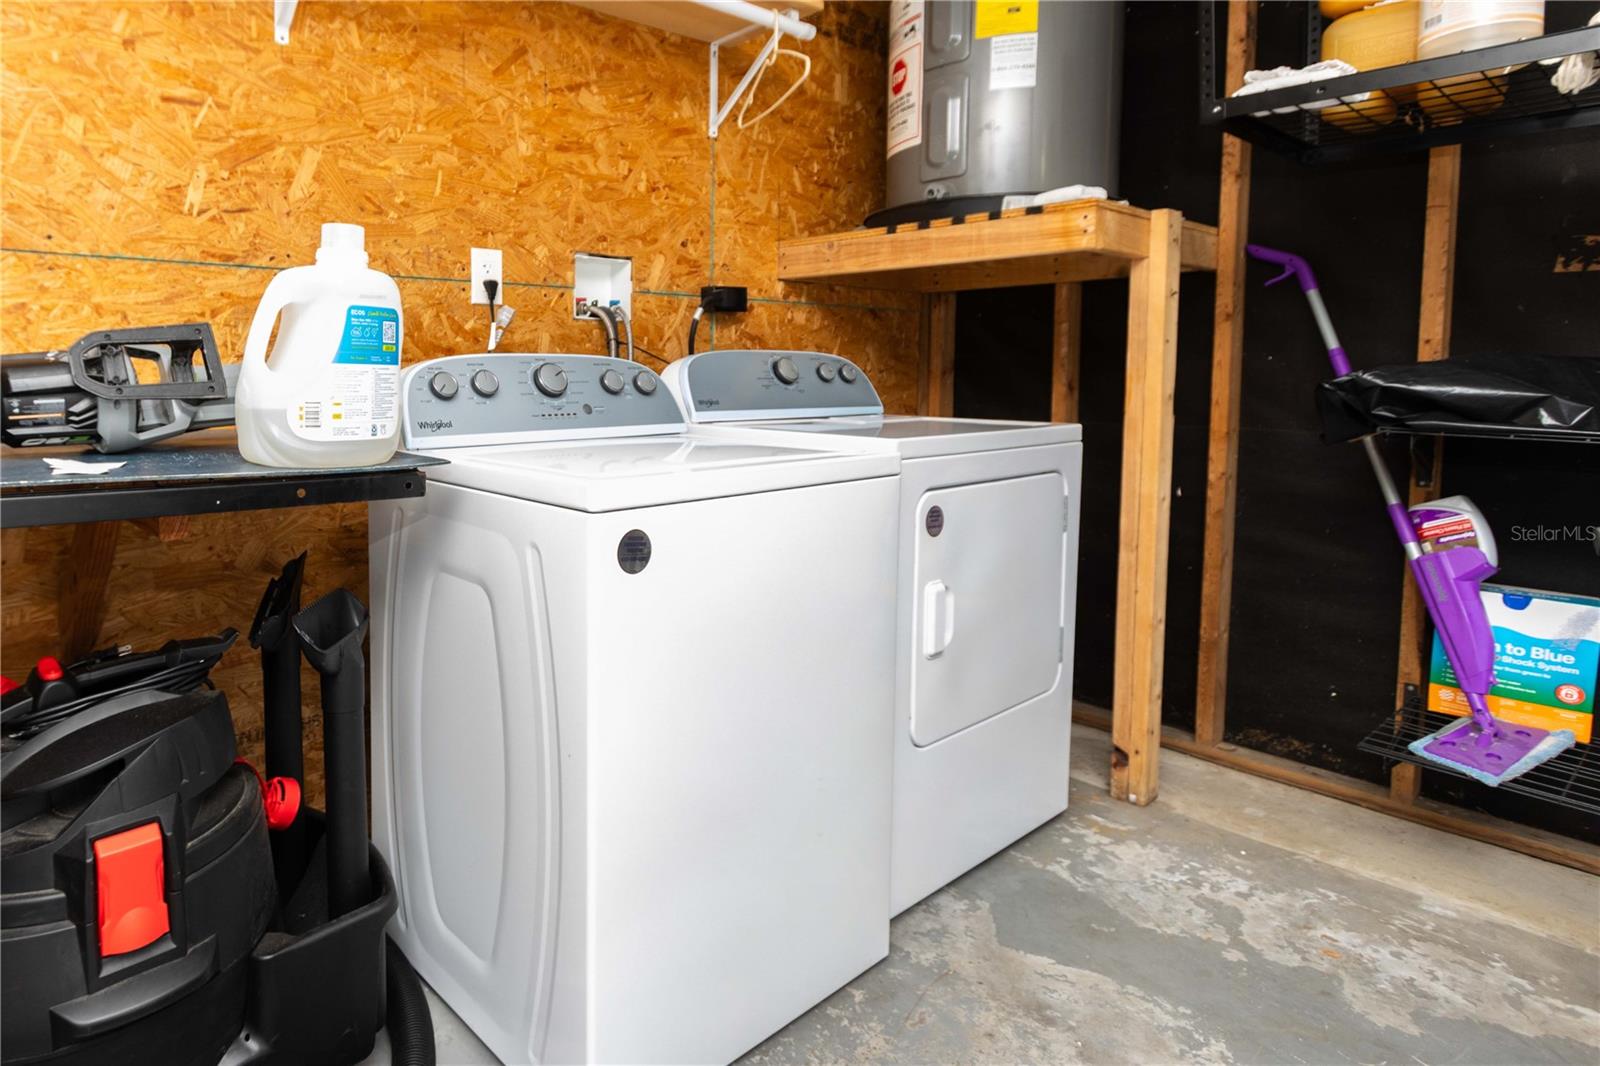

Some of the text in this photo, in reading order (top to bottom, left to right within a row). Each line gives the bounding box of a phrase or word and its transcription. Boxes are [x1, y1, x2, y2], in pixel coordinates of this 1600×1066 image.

[417, 420, 453, 433] Whirlpool
[1504, 642, 1526, 657] to
[1530, 646, 1576, 665] Blue
[1537, 661, 1580, 676] System
